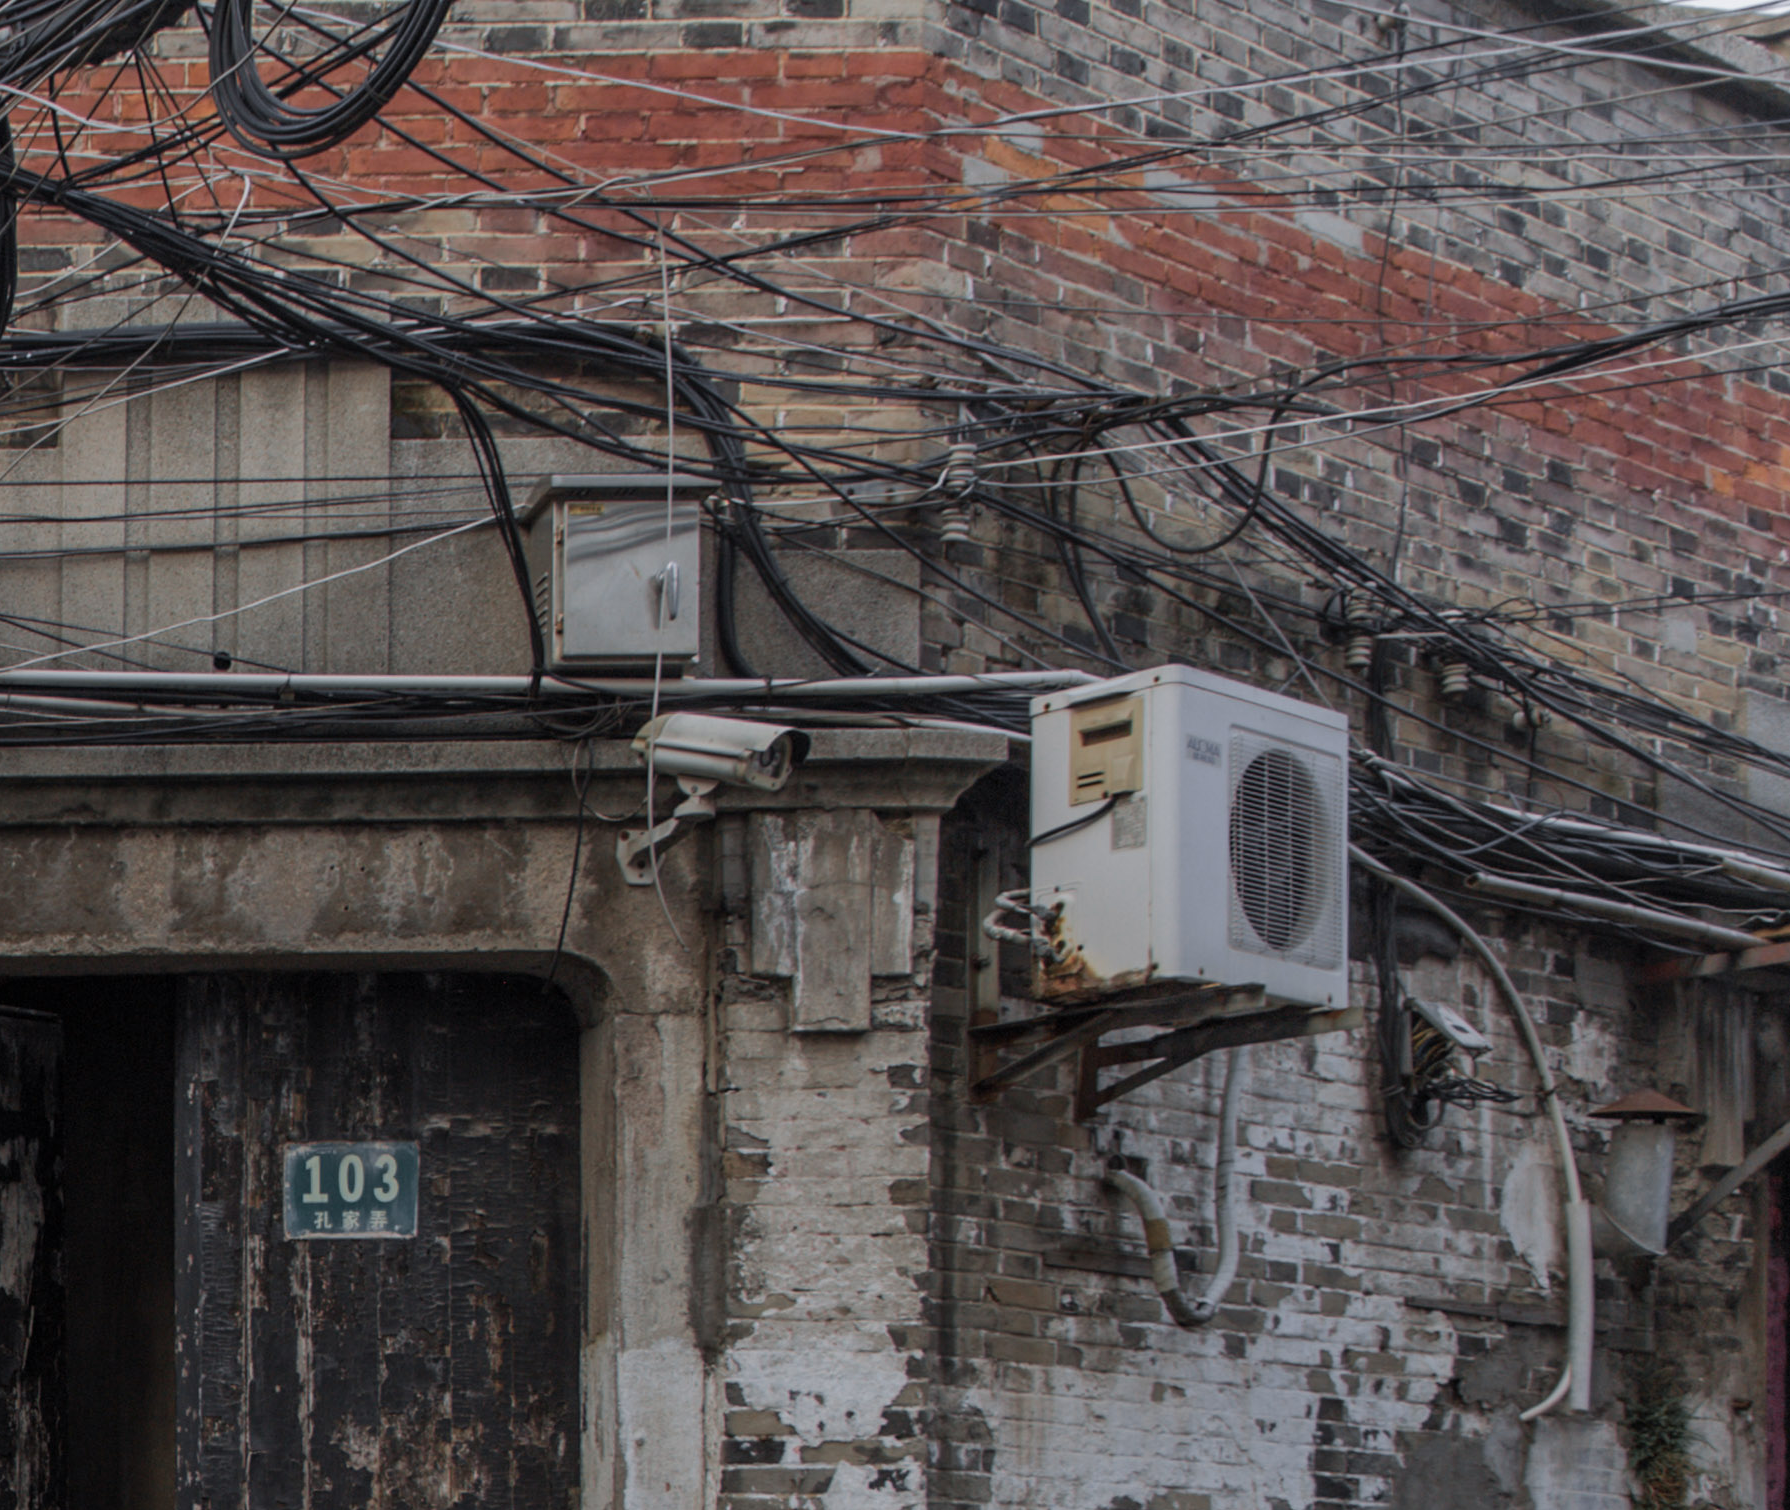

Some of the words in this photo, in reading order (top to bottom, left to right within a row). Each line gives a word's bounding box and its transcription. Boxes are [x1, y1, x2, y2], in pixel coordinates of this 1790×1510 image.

[302, 1153, 400, 1204] 103
[314, 1210, 388, 1230] 孔家弄
